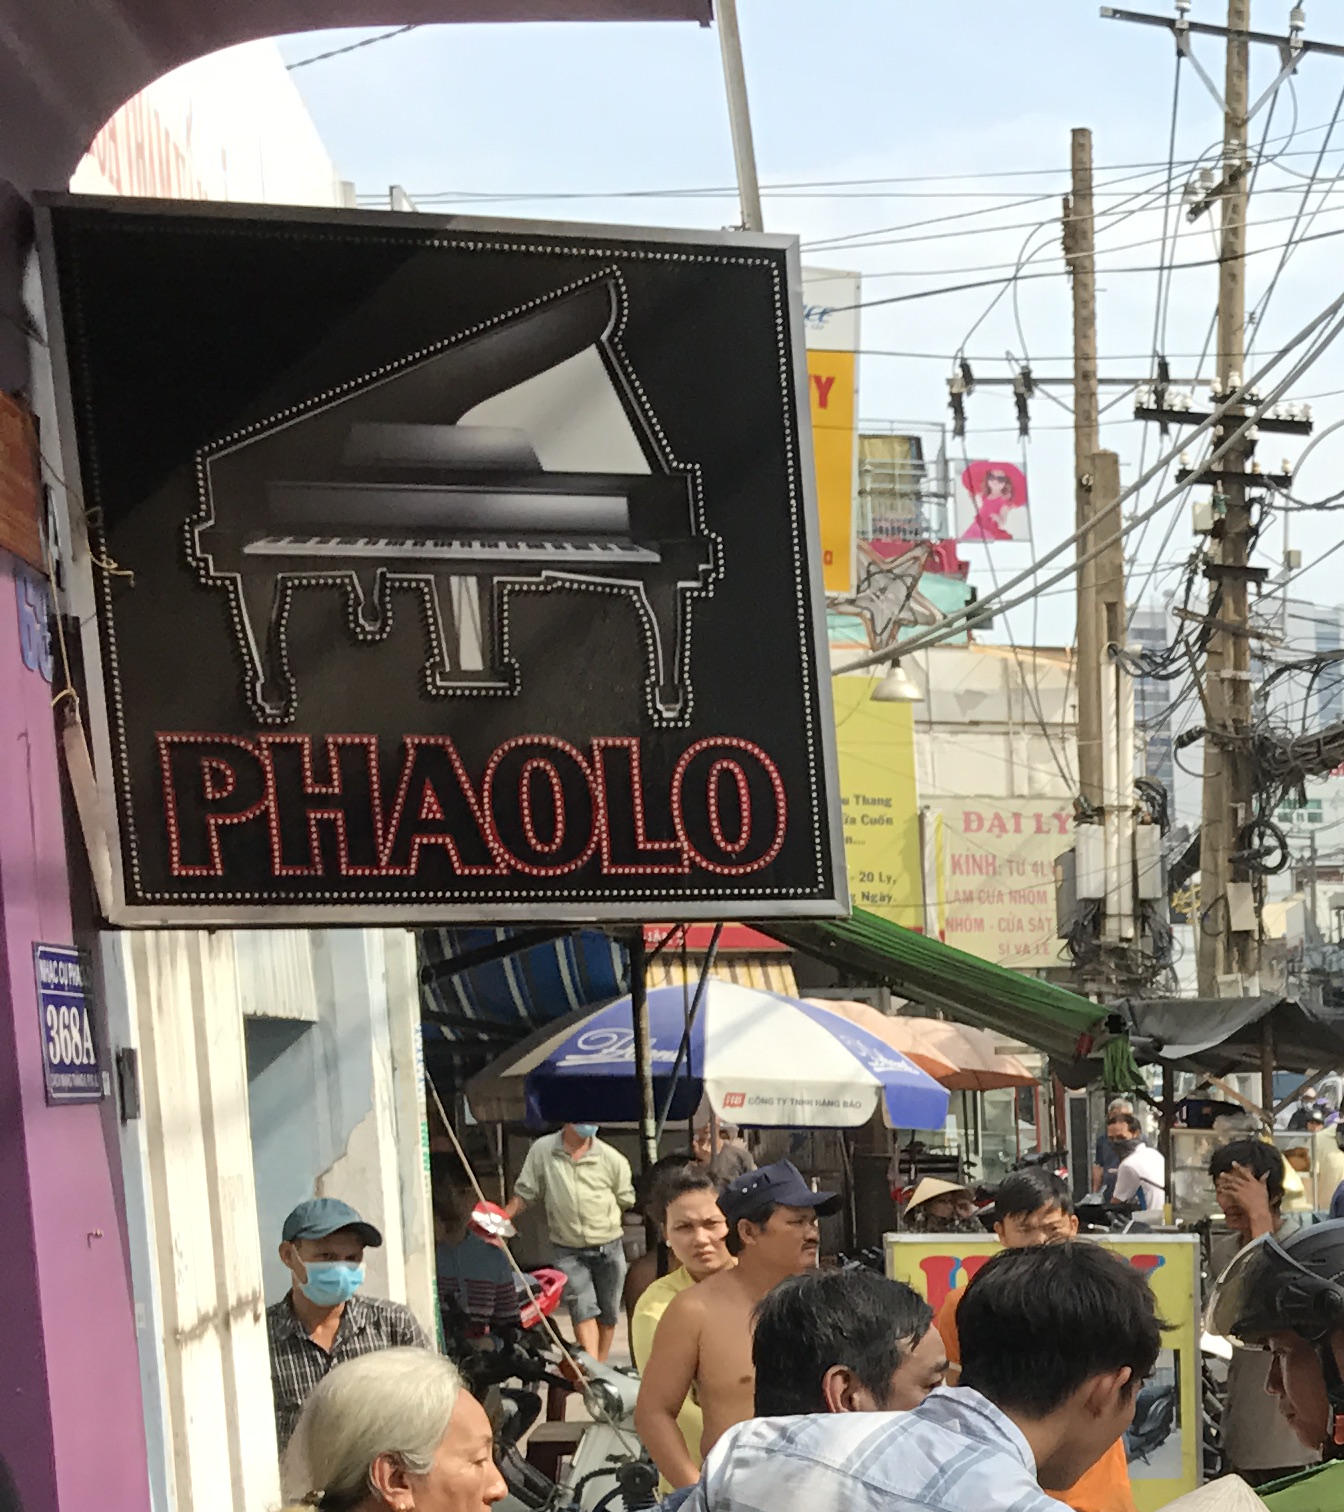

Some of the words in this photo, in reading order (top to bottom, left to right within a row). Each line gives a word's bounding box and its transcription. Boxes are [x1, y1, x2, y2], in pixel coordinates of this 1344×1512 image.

[154, 731, 788, 877] PHAOLO
[854, 794, 892, 808] Thang
[962, 811, 1023, 839] ĐẠI
[859, 870, 874, 883] 20
[46, 1004, 97, 1066] 368A
